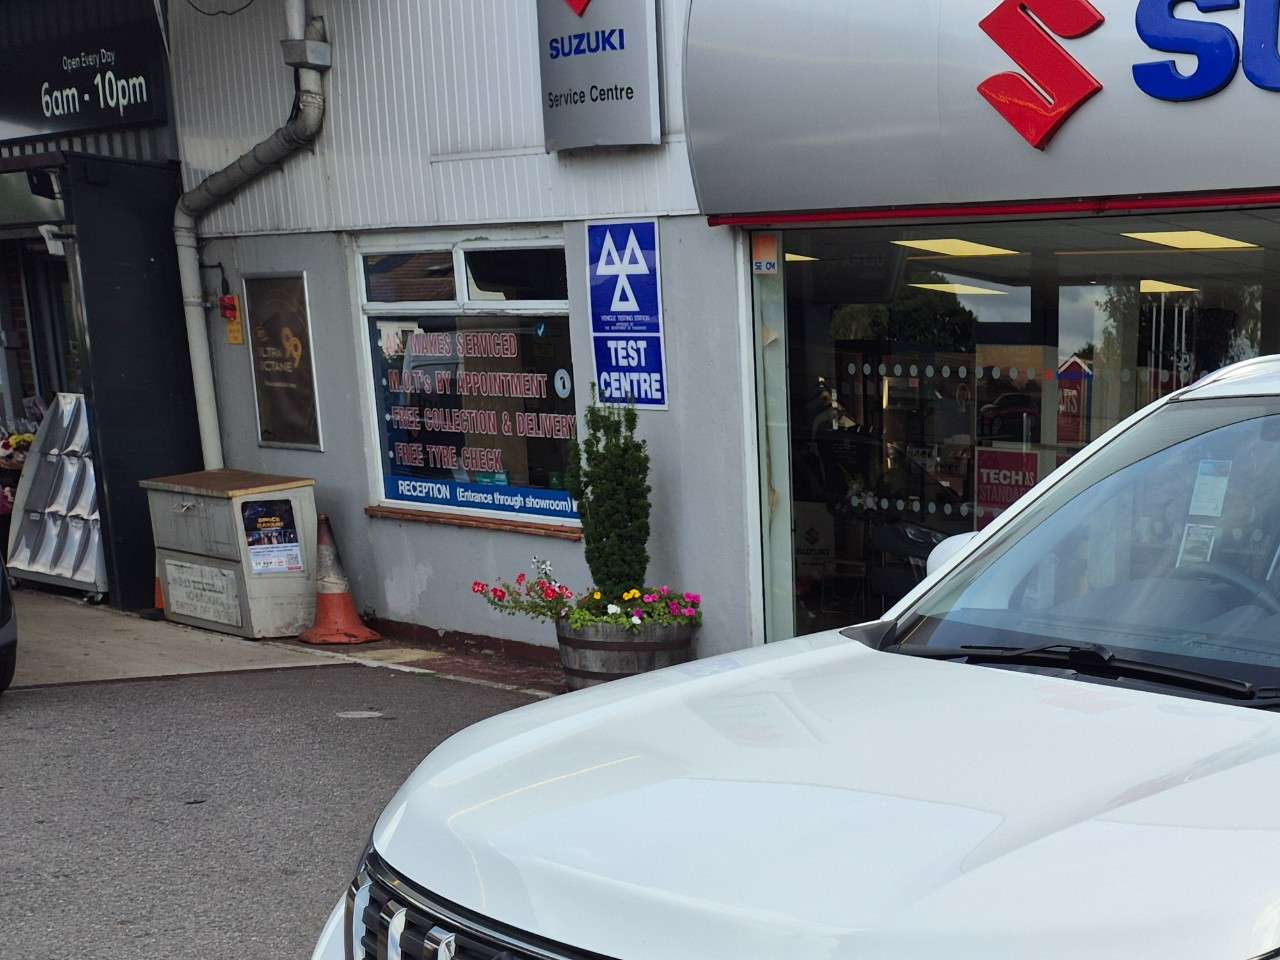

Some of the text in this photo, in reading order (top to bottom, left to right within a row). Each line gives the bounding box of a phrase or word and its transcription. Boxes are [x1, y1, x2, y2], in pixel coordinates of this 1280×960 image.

[549, 28, 625, 60] SUZUKI
[62, 48, 115, 72] Open Every Day
[41, 81, 80, 117] 6am
[93, 70, 148, 117] 10pm
[547, 84, 634, 109] Service Centre
[411, 332, 453, 356] MAKES
[456, 332, 518, 358] SERVICED
[607, 340, 647, 367] TEST
[435, 370, 452, 395] BY
[456, 372, 548, 398] APPOINTMENT
[600, 371, 662, 399] CENTRE
[391, 406, 577, 440] FREE COLLECTION & DELIVERY
[394, 442, 503, 473] FREE TYRE CHECK
[980, 468, 1035, 487] TECH AS
[398, 479, 572, 512] RECEPTION (Entrance through showroom)
